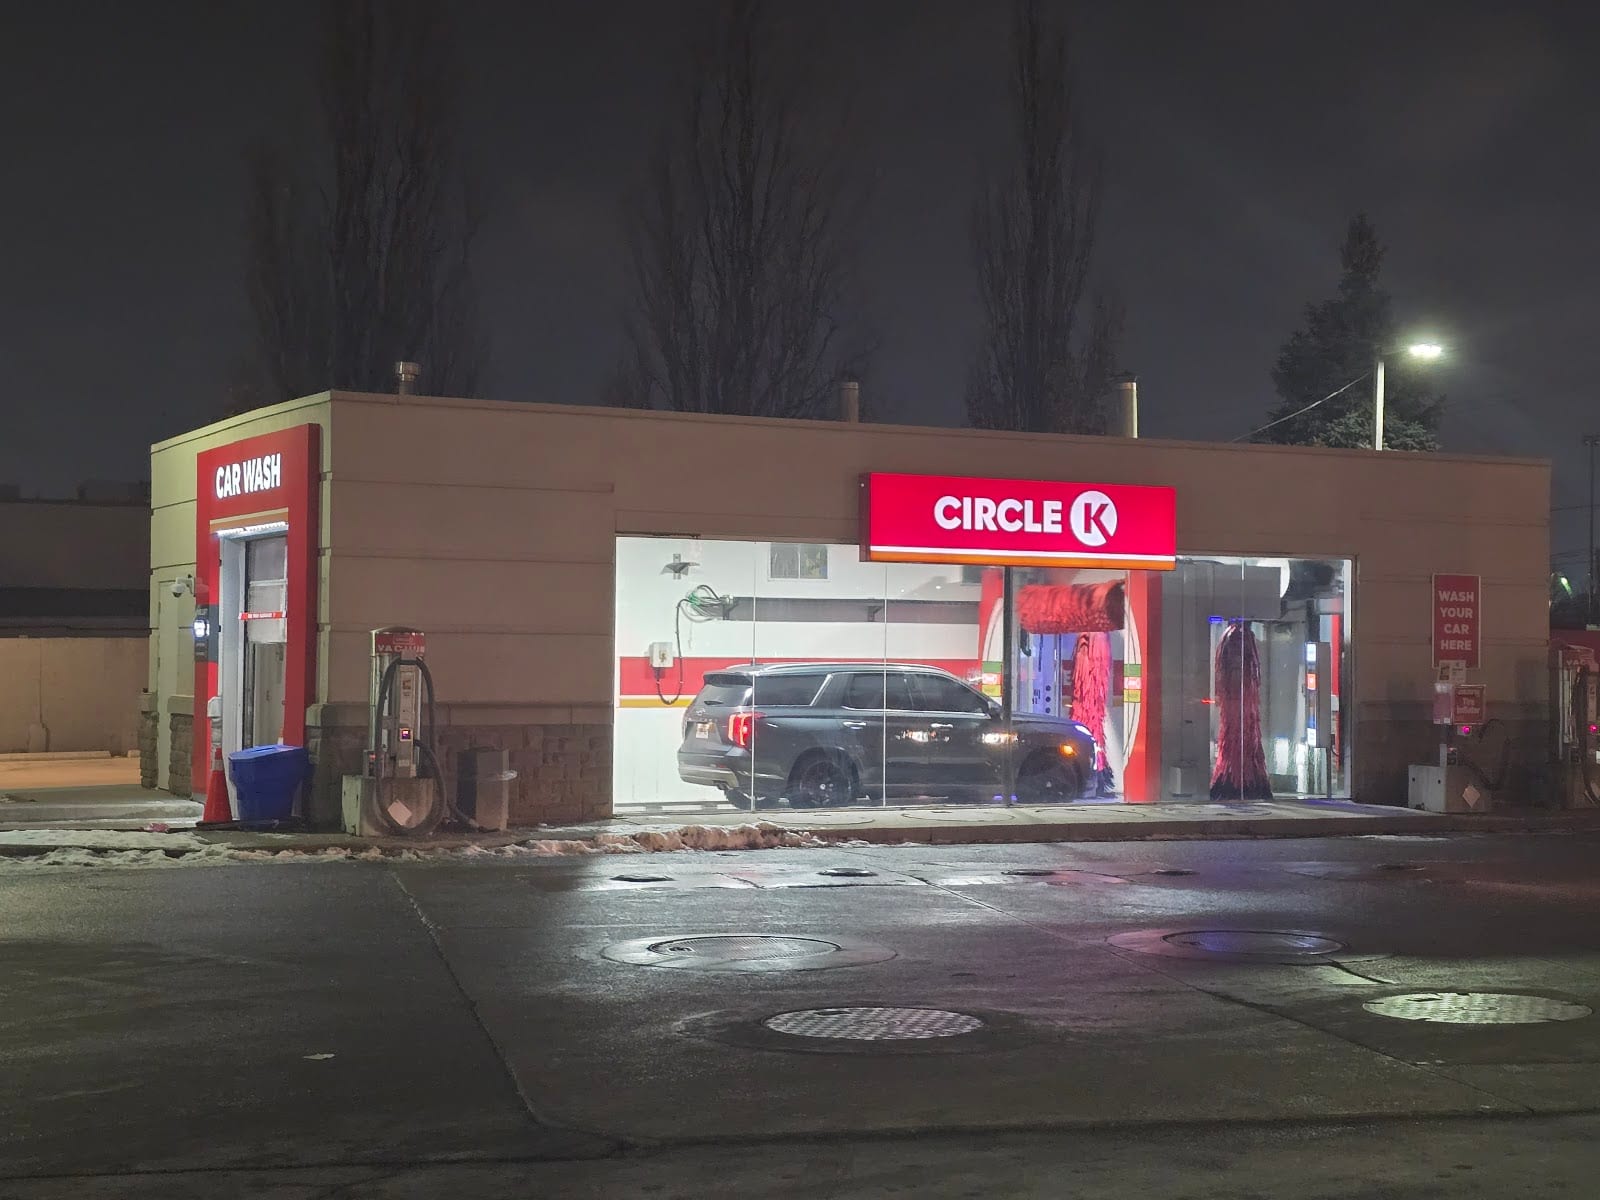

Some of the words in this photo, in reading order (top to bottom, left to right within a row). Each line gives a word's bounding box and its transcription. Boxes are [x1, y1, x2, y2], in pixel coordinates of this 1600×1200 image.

[216, 463, 241, 499] CAR
[243, 453, 281, 493] WASH
[934, 495, 1063, 533] CIRCLE
[1082, 501, 1115, 544] K
[1438, 590, 1475, 602] WASH
[1440, 607, 1473, 619] YOUR
[1443, 623, 1469, 634] CAR
[1440, 639, 1473, 651] HERE
